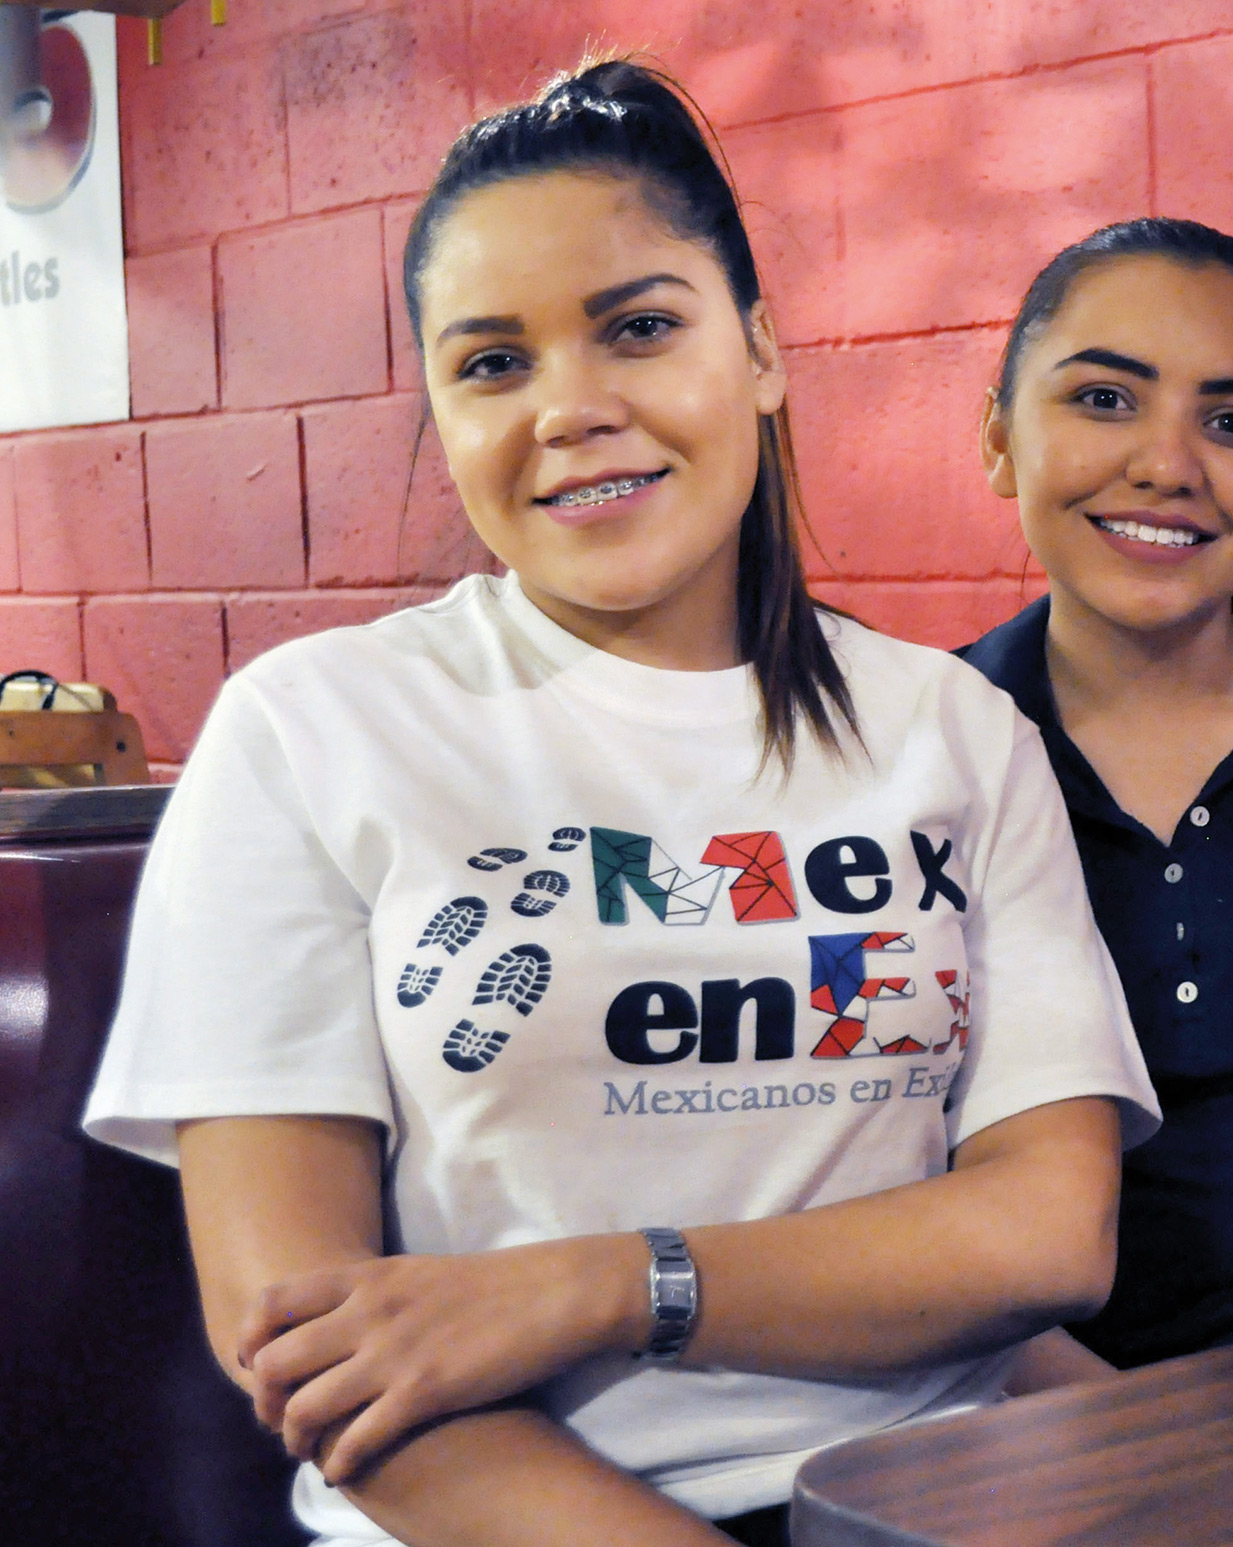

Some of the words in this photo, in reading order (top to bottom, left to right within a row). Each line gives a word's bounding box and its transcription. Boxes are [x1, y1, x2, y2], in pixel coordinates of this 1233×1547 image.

[590, 826, 967, 925] Mex
[603, 1079, 836, 1115] Mexicanos
[849, 1077, 892, 1102] en
